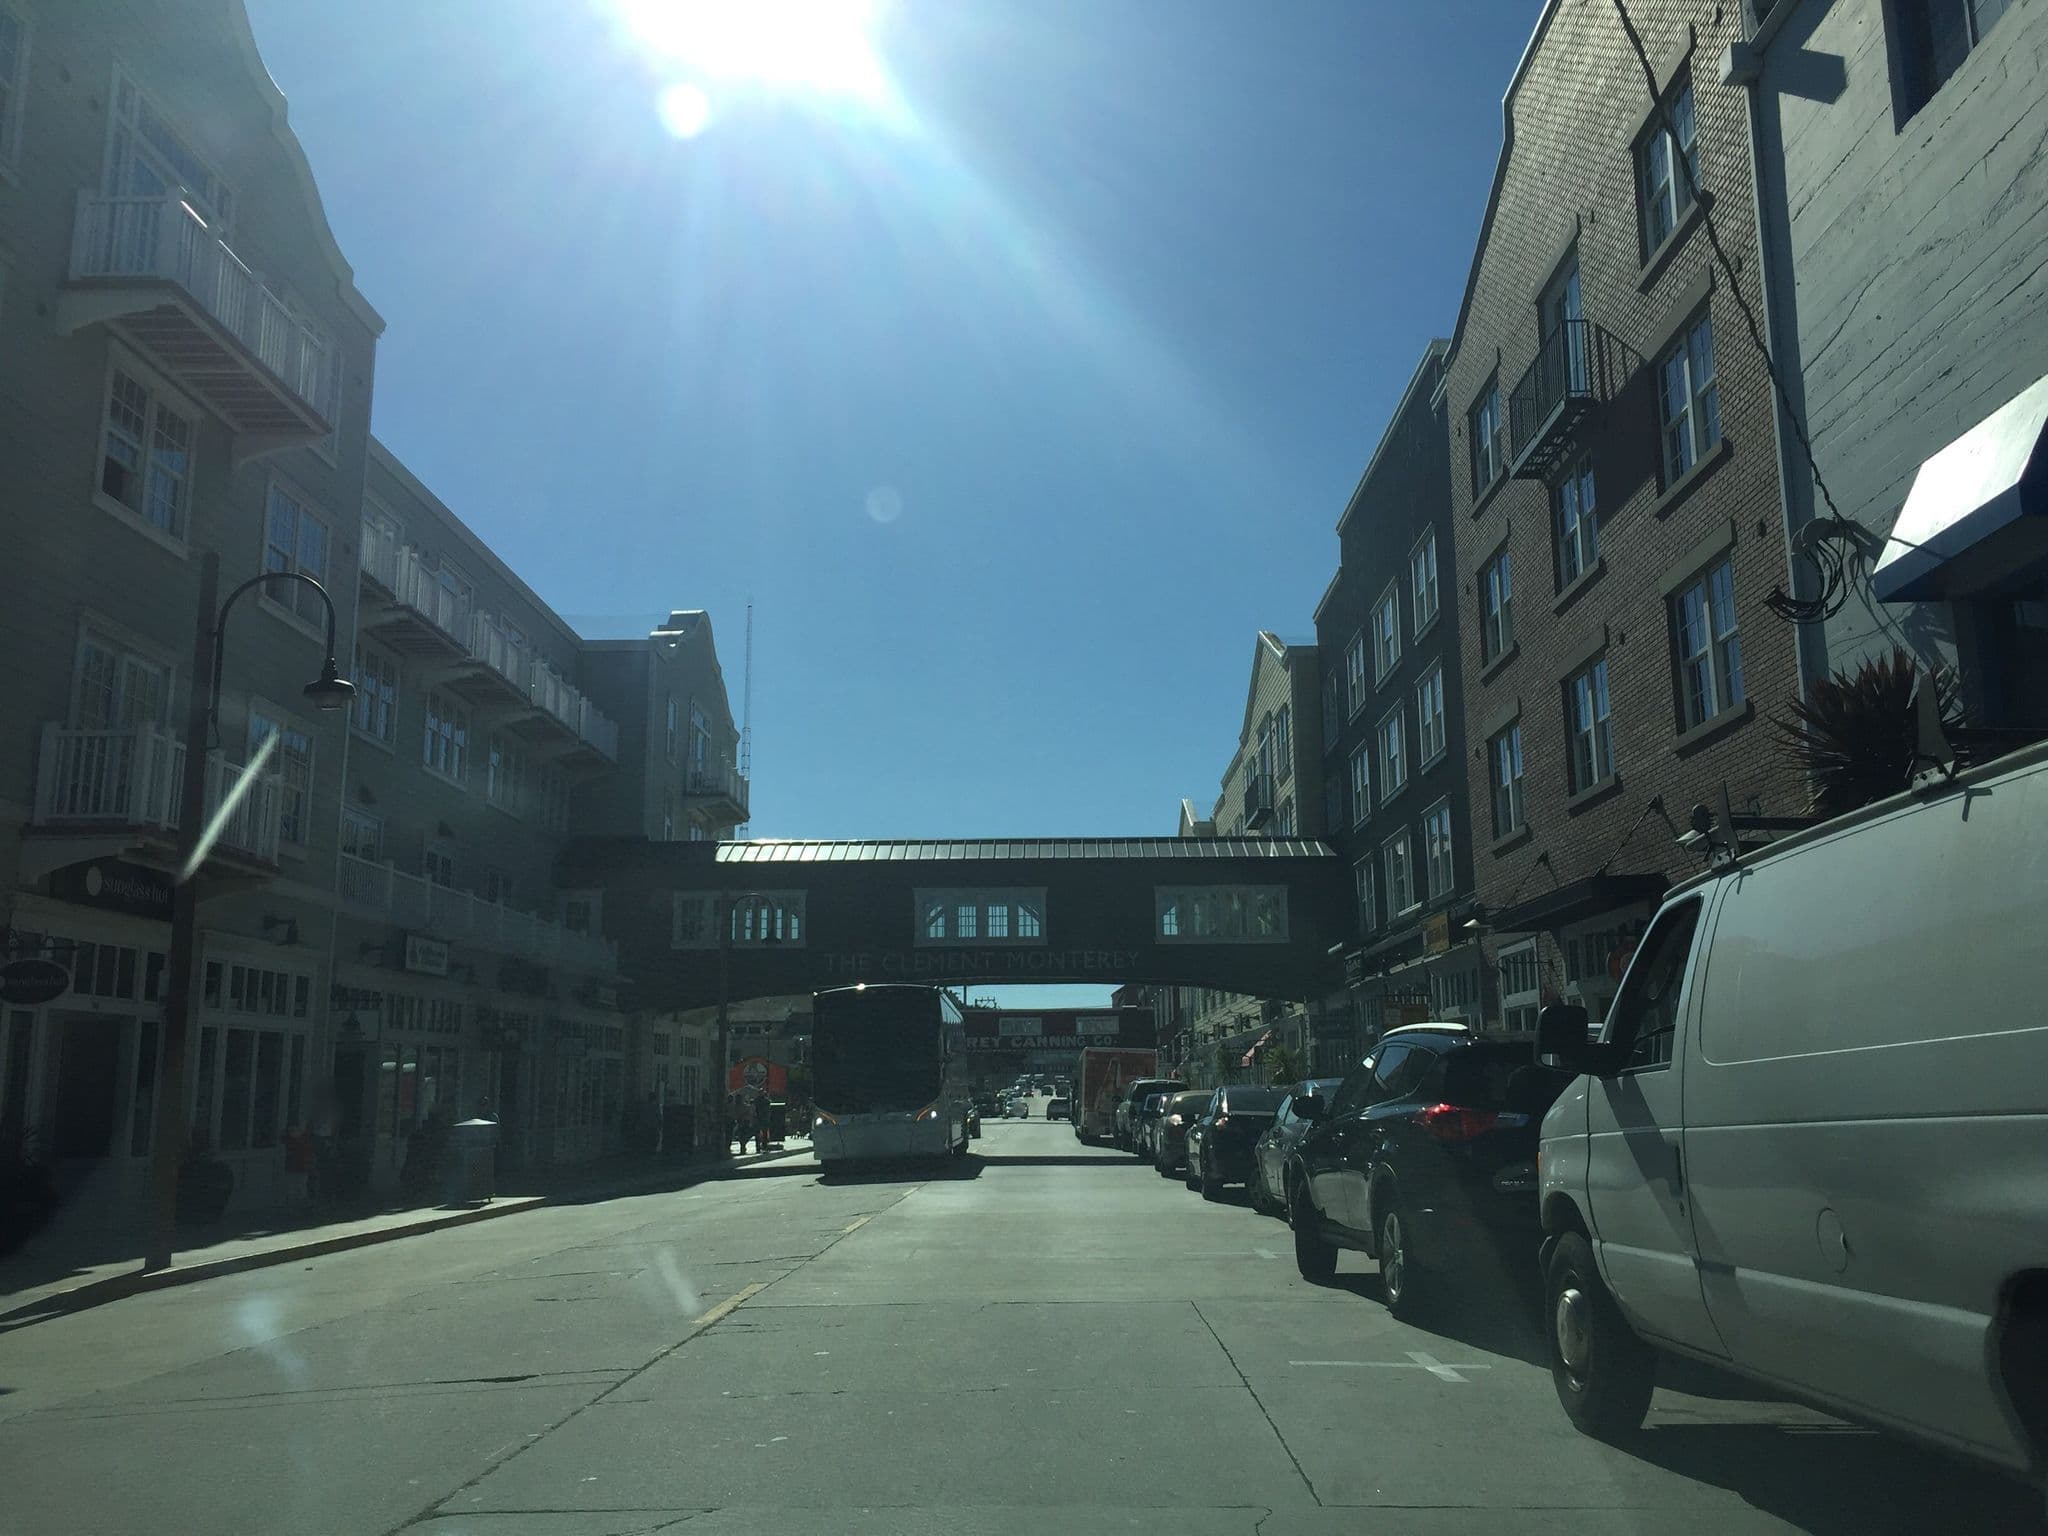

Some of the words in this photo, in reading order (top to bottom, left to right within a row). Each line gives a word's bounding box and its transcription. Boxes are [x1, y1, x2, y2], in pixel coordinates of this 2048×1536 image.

[824, 952, 873, 971] THE
[881, 951, 995, 971] CLEMENT
[1007, 950, 1139, 969] MONTEREY
[1011, 1035, 1088, 1049] CANNING
